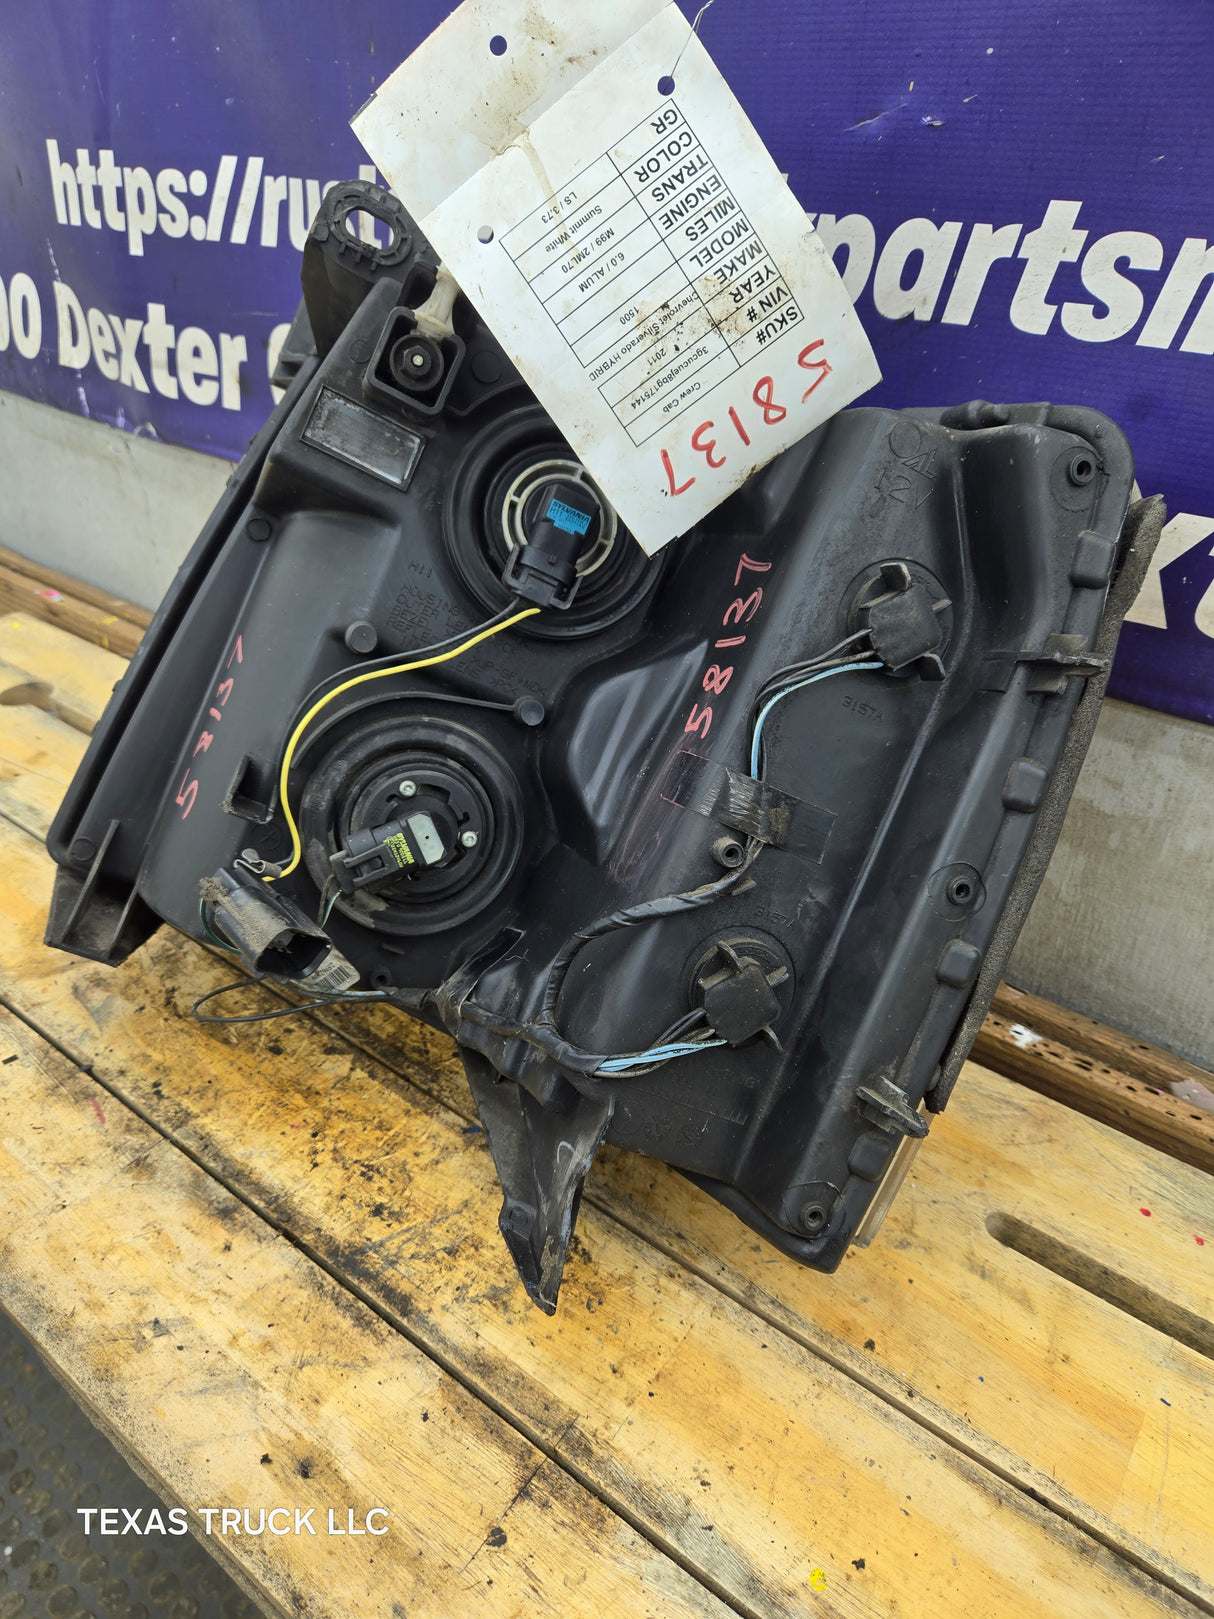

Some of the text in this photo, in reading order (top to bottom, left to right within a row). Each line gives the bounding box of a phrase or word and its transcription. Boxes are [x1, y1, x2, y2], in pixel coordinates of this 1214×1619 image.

[650, 109, 677, 134] GR
[634, 132, 692, 182] COLOR
[652, 155, 708, 201] TRANS
[542, 206, 559, 223] 3.73
[564, 192, 577, 205] LS
[659, 174, 721, 230] ENGINE
[546, 206, 602, 251] Summit White
[686, 197, 735, 241] MILES
[596, 228, 614, 245] M99
[690, 219, 749, 267] MODEL
[562, 248, 590, 273] 2ML70
[611, 253, 624, 266] 6.0
[714, 241, 762, 285] MAKE
[579, 267, 604, 292] ALUM
[729, 265, 776, 303] YEAR
[620, 307, 639, 324] 1500
[659, 290, 700, 325] Chevrolet
[759, 286, 788, 313] VIN
[621, 323, 659, 354] Silverado
[756, 306, 798, 345] SKU#
[53, 281, 248, 411] Dexter
[647, 348, 666, 366] 2011
[663, 383, 700, 412] Crew Cab
[661, 339, 832, 496] 58137
[552, 501, 590, 523] SYLVANIA
[684, 554, 771, 738] 58137
